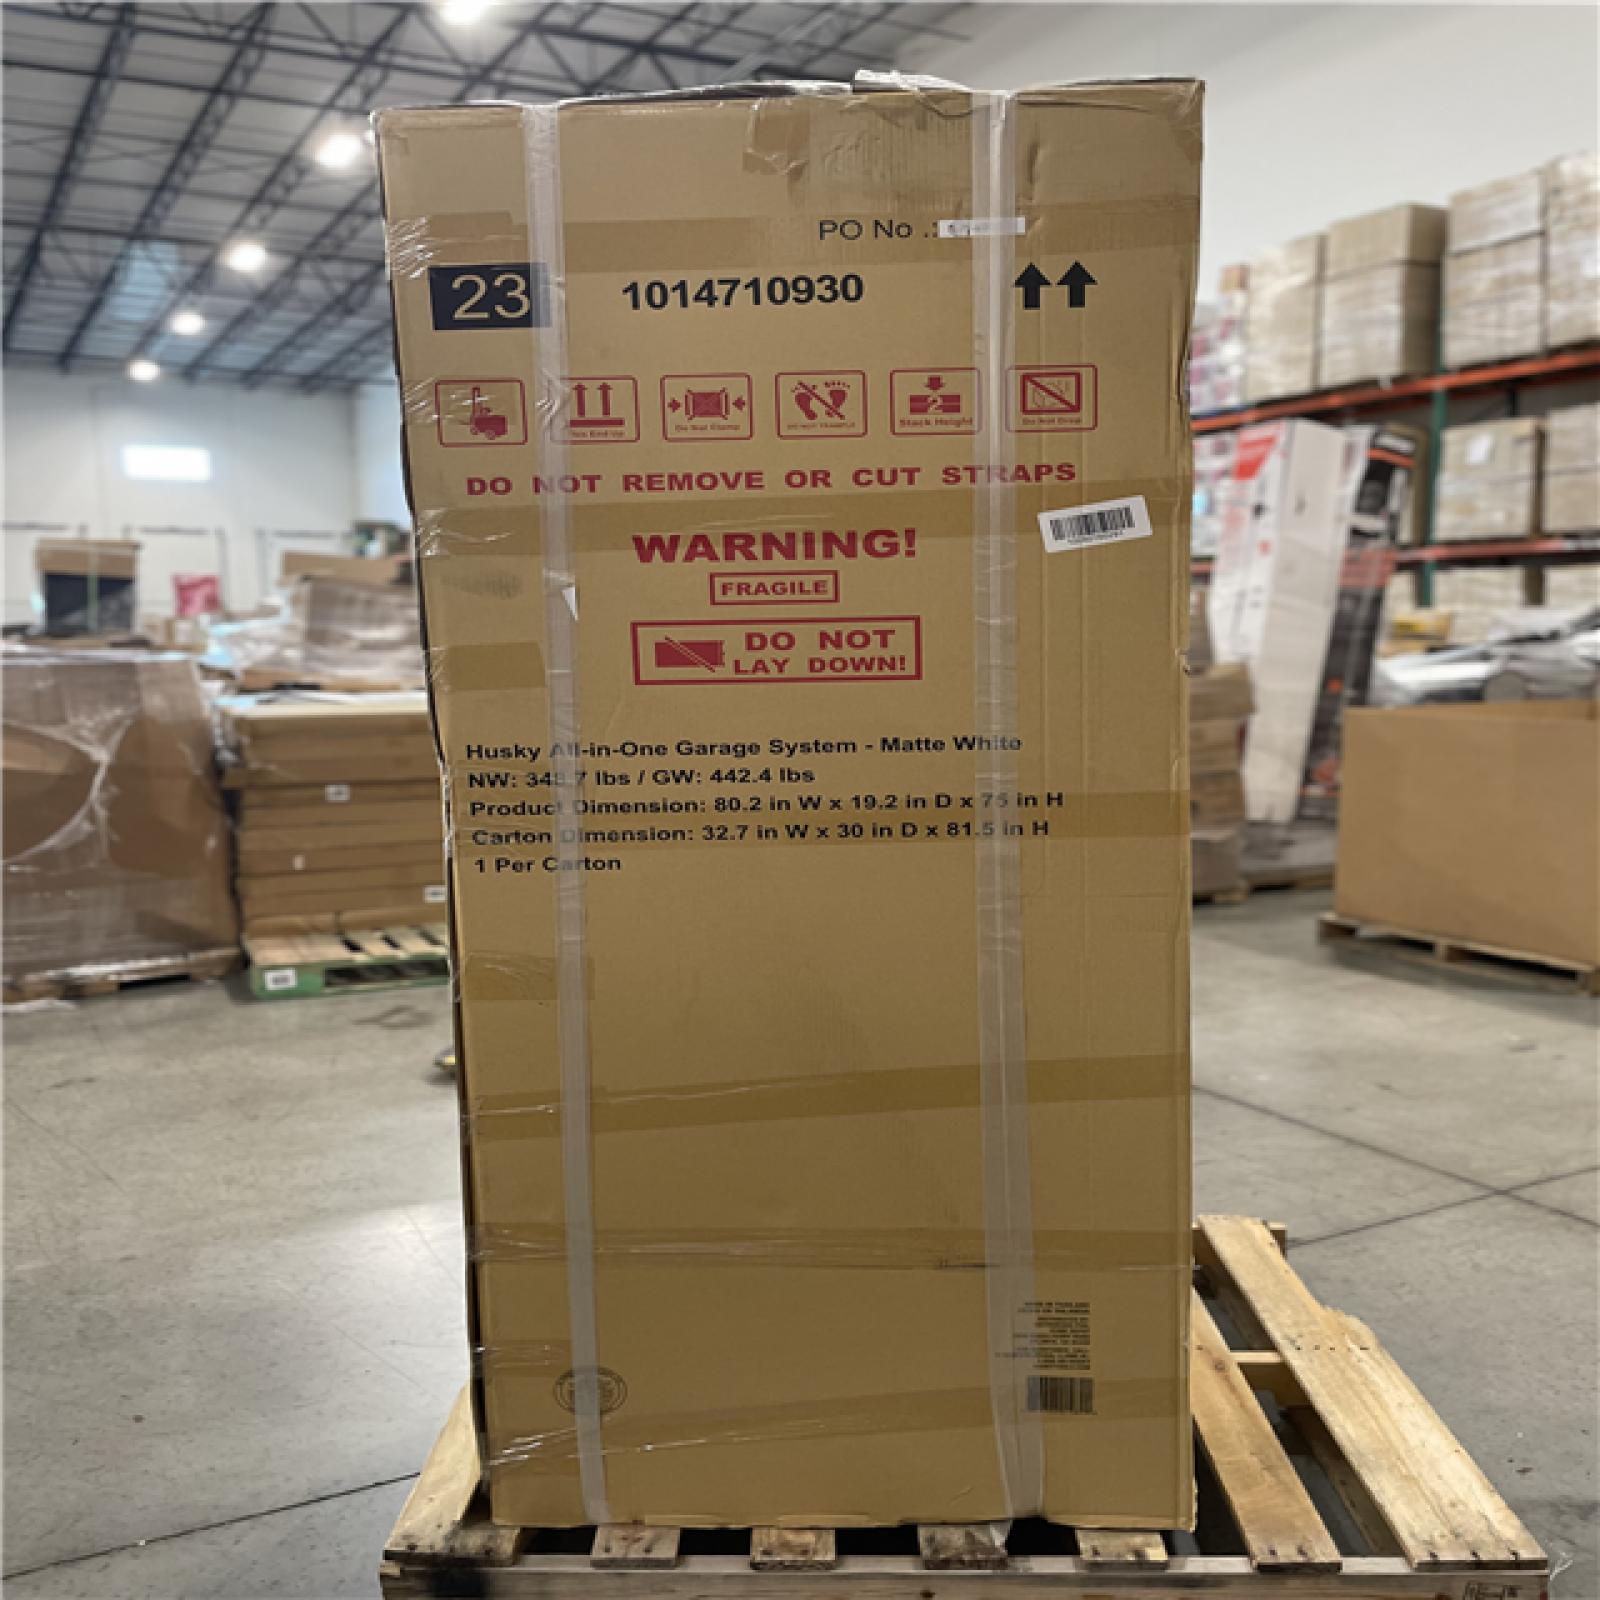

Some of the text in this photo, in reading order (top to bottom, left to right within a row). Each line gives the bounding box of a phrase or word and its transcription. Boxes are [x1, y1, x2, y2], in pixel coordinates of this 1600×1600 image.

[819, 219, 863, 241] PO
[874, 219, 913, 239] No
[452, 274, 531, 321] 23
[622, 274, 864, 310] 1014710930
[900, 417, 973, 428] Stack Height
[466, 462, 1076, 496] DO NOT REMOVE OR CUT STRAPS
[631, 528, 916, 563] WARNING!
[720, 579, 829, 596] FRAGILE
[744, 629, 896, 651] DO NOT
[733, 655, 906, 675] LAY DOWN!
[466, 743, 541, 762] Husky
[549, 740, 669, 758] All-in-One
[675, 740, 761, 758] Garage
[769, 738, 857, 757] System
[880, 736, 946, 752] Matte
[952, 735, 1022, 751] White
[468, 772, 516, 788] NW:
[595, 770, 631, 786] lbs
[637, 769, 646, 786] /
[652, 769, 702, 785] GW:
[709, 768, 772, 784] 442.4
[779, 767, 816, 783] lbs
[470, 792, 1064, 816] Product Dimension: 80.2 in W x 19.2 in D x 75 in H
[472, 820, 1049, 845] Carton Dimension: 32.7 in W x 30 in D x 81.5 in H
[474, 856, 622, 874] 1 Per Carton
